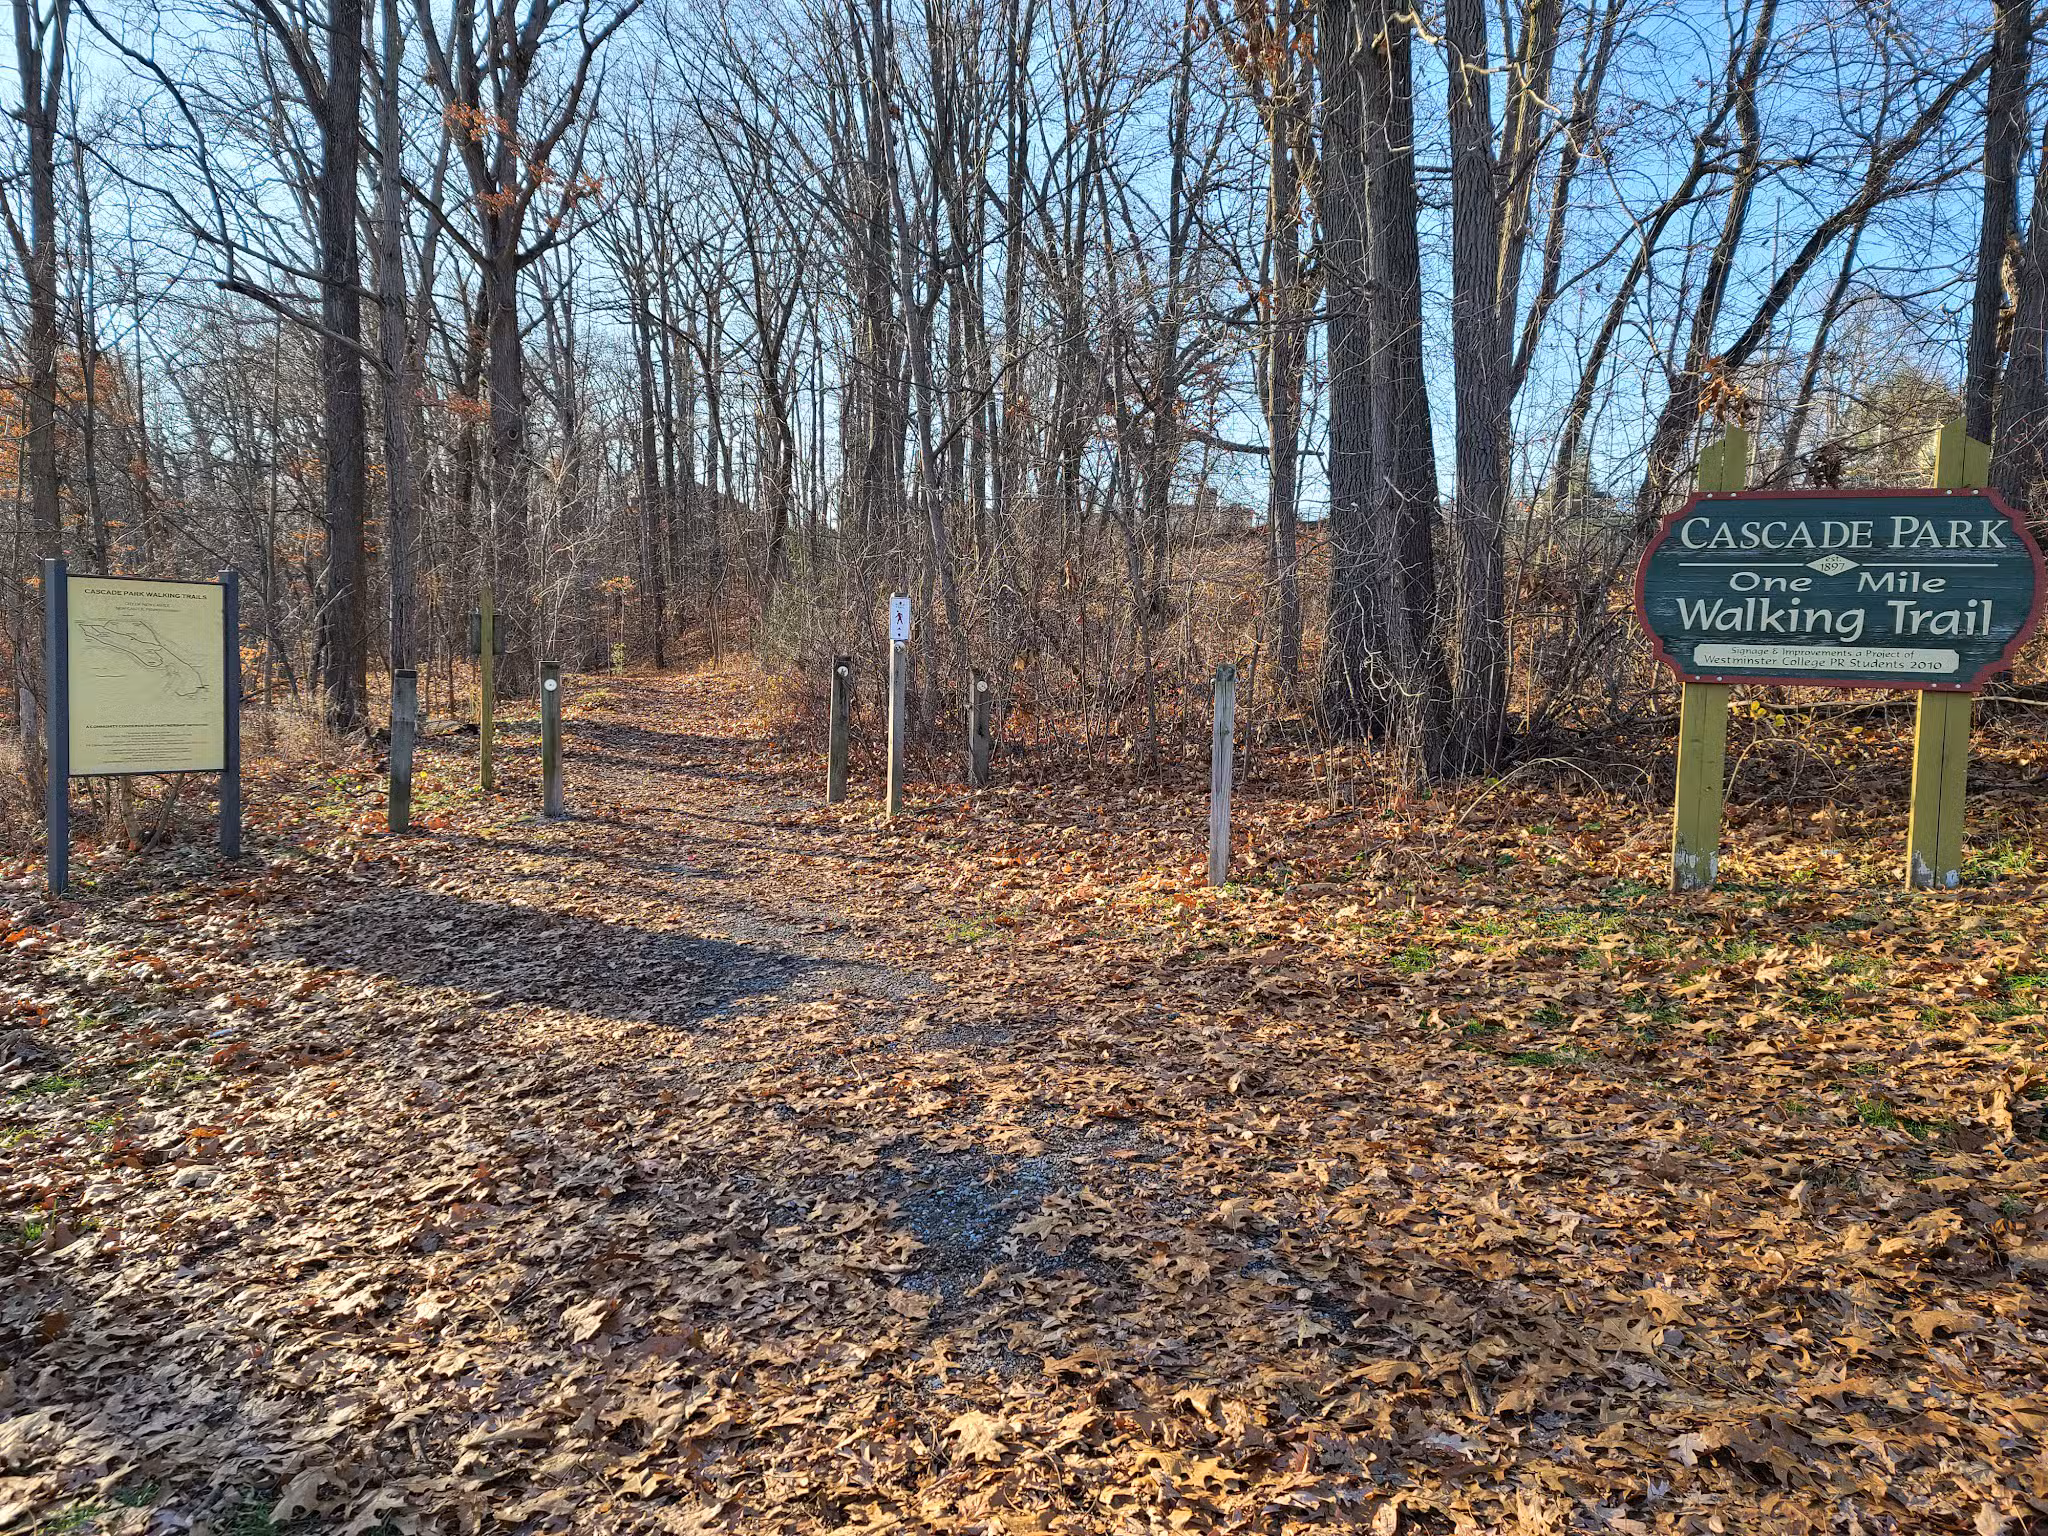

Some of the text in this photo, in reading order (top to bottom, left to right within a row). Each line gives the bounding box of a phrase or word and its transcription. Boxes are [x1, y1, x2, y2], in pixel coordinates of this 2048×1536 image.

[1680, 515, 2008, 549] CASCADE PARK
[1820, 562, 1845, 571] 1897
[1729, 571, 1946, 593] One Mile
[84, 588, 122, 596] CASCADE
[146, 591, 180, 599] WALKING
[1677, 597, 1992, 642] Walking Trail
[1731, 646, 1769, 656] Signage
[1772, 647, 1779, 655] &
[1782, 648, 1852, 657] Improvements
[1866, 649, 1900, 659] Project
[1904, 650, 1916, 659] of
[1704, 654, 1942, 670] Westminster College PR Students 2010
